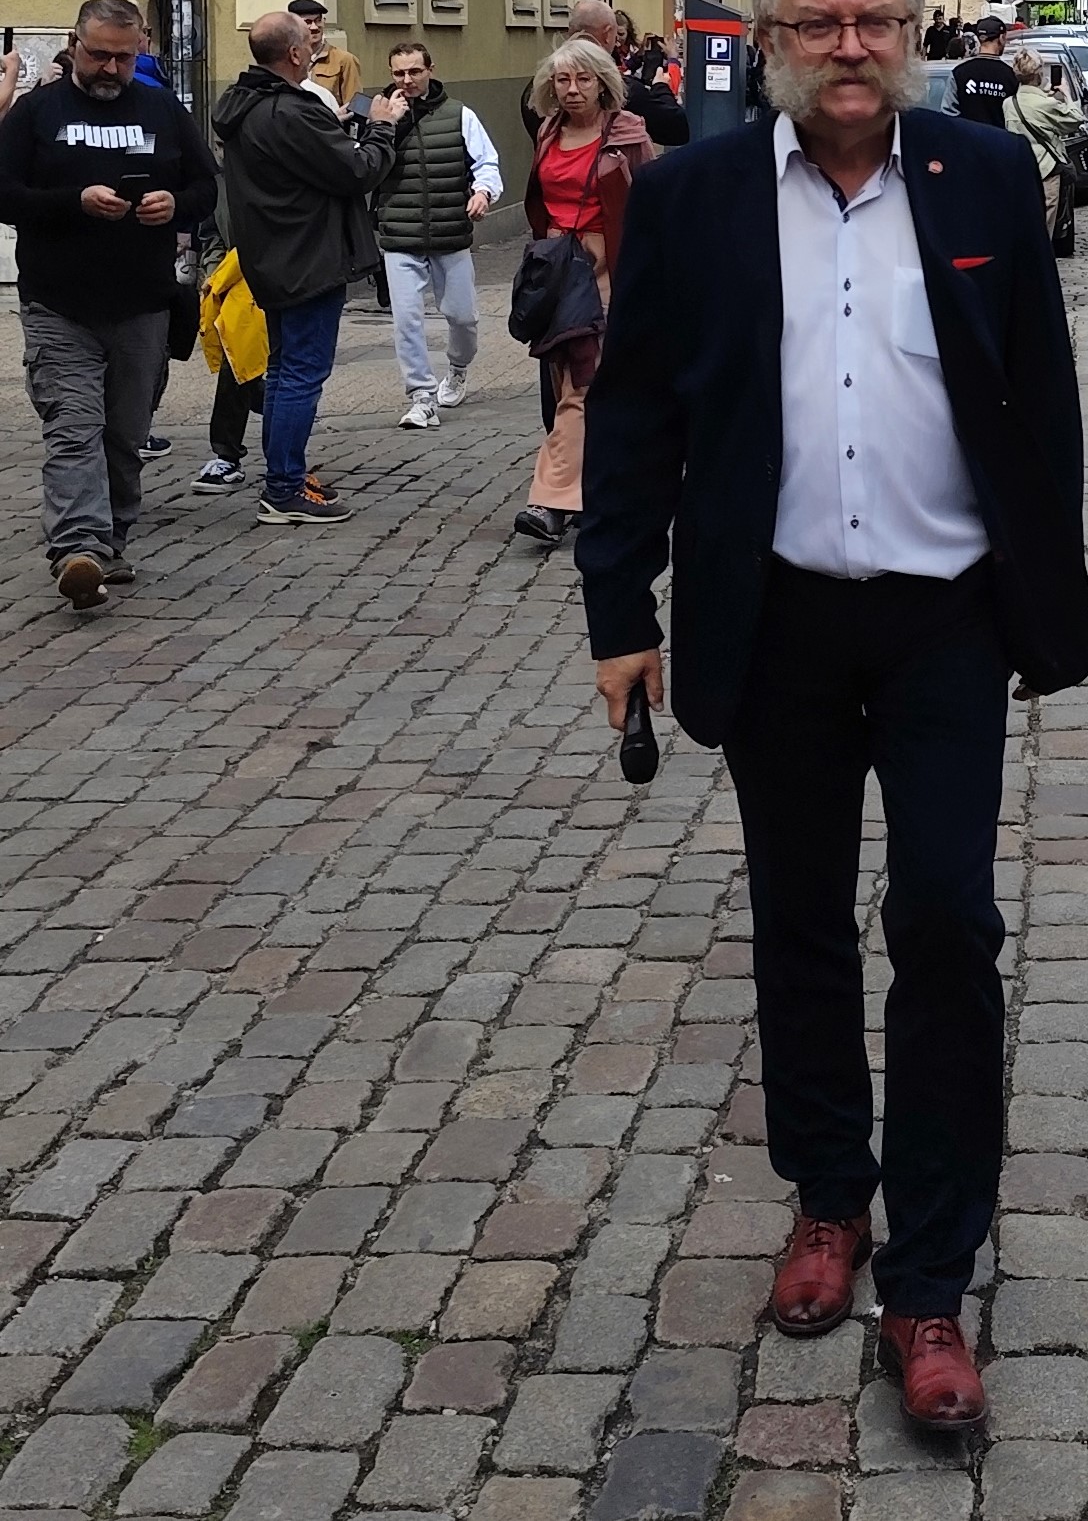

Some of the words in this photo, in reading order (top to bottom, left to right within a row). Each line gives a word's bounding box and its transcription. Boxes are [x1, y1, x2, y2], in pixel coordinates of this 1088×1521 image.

[711, 38, 728, 58] P
[979, 81, 1004, 91] SOLID
[979, 88, 1007, 98] STUDIO
[66, 124, 145, 148] PUMA
